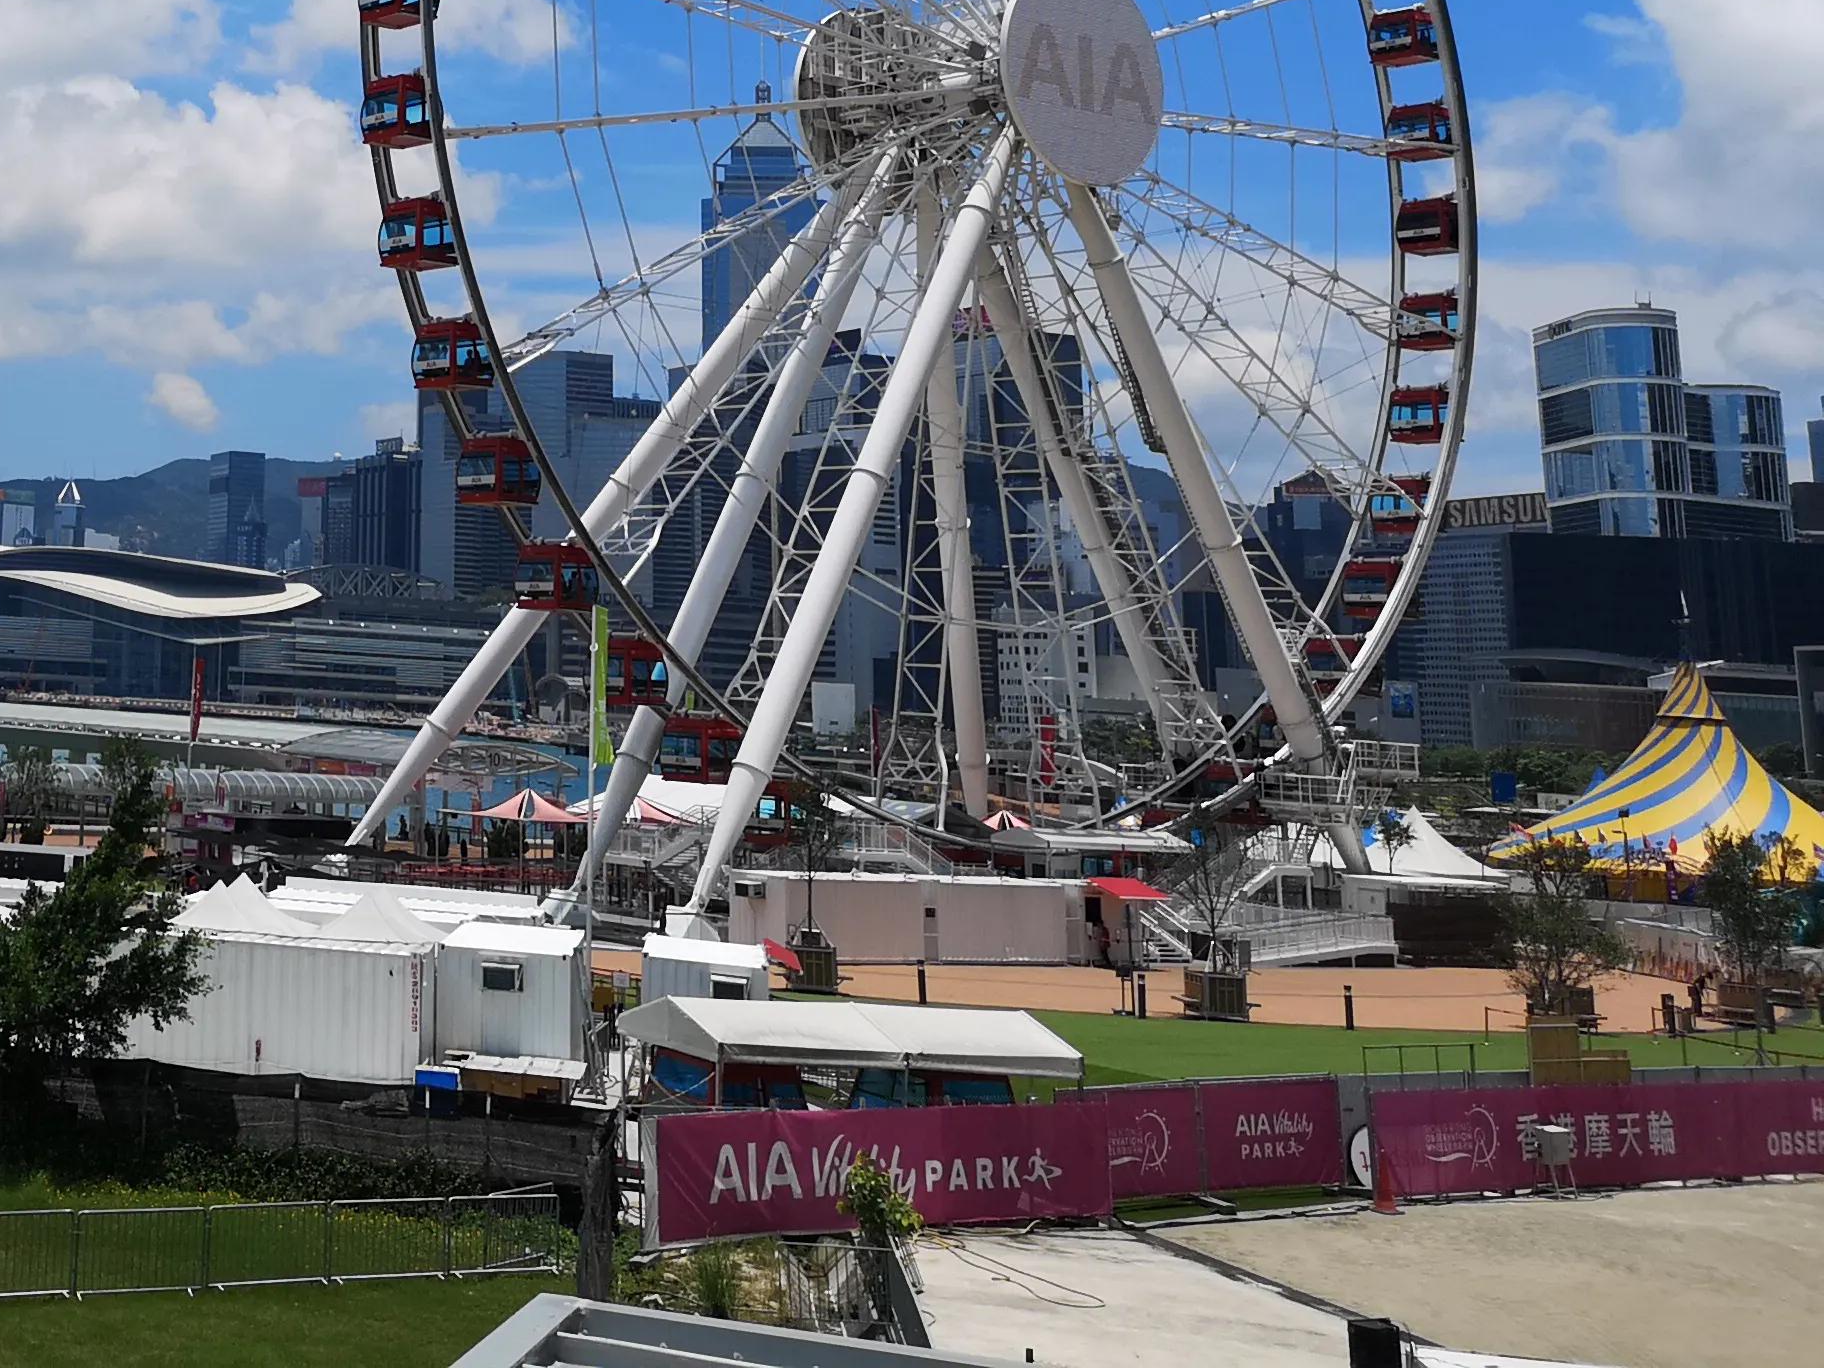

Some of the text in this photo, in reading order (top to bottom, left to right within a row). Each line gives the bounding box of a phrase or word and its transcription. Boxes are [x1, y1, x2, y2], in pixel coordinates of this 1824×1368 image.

[1018, 23, 1155, 126] AIA
[488, 752, 501, 768] 10
[1236, 1108, 1313, 1141] AIA Vitality
[1241, 1141, 1285, 1160] PARK
[709, 1134, 1022, 1205] AIA Vitty PARK
